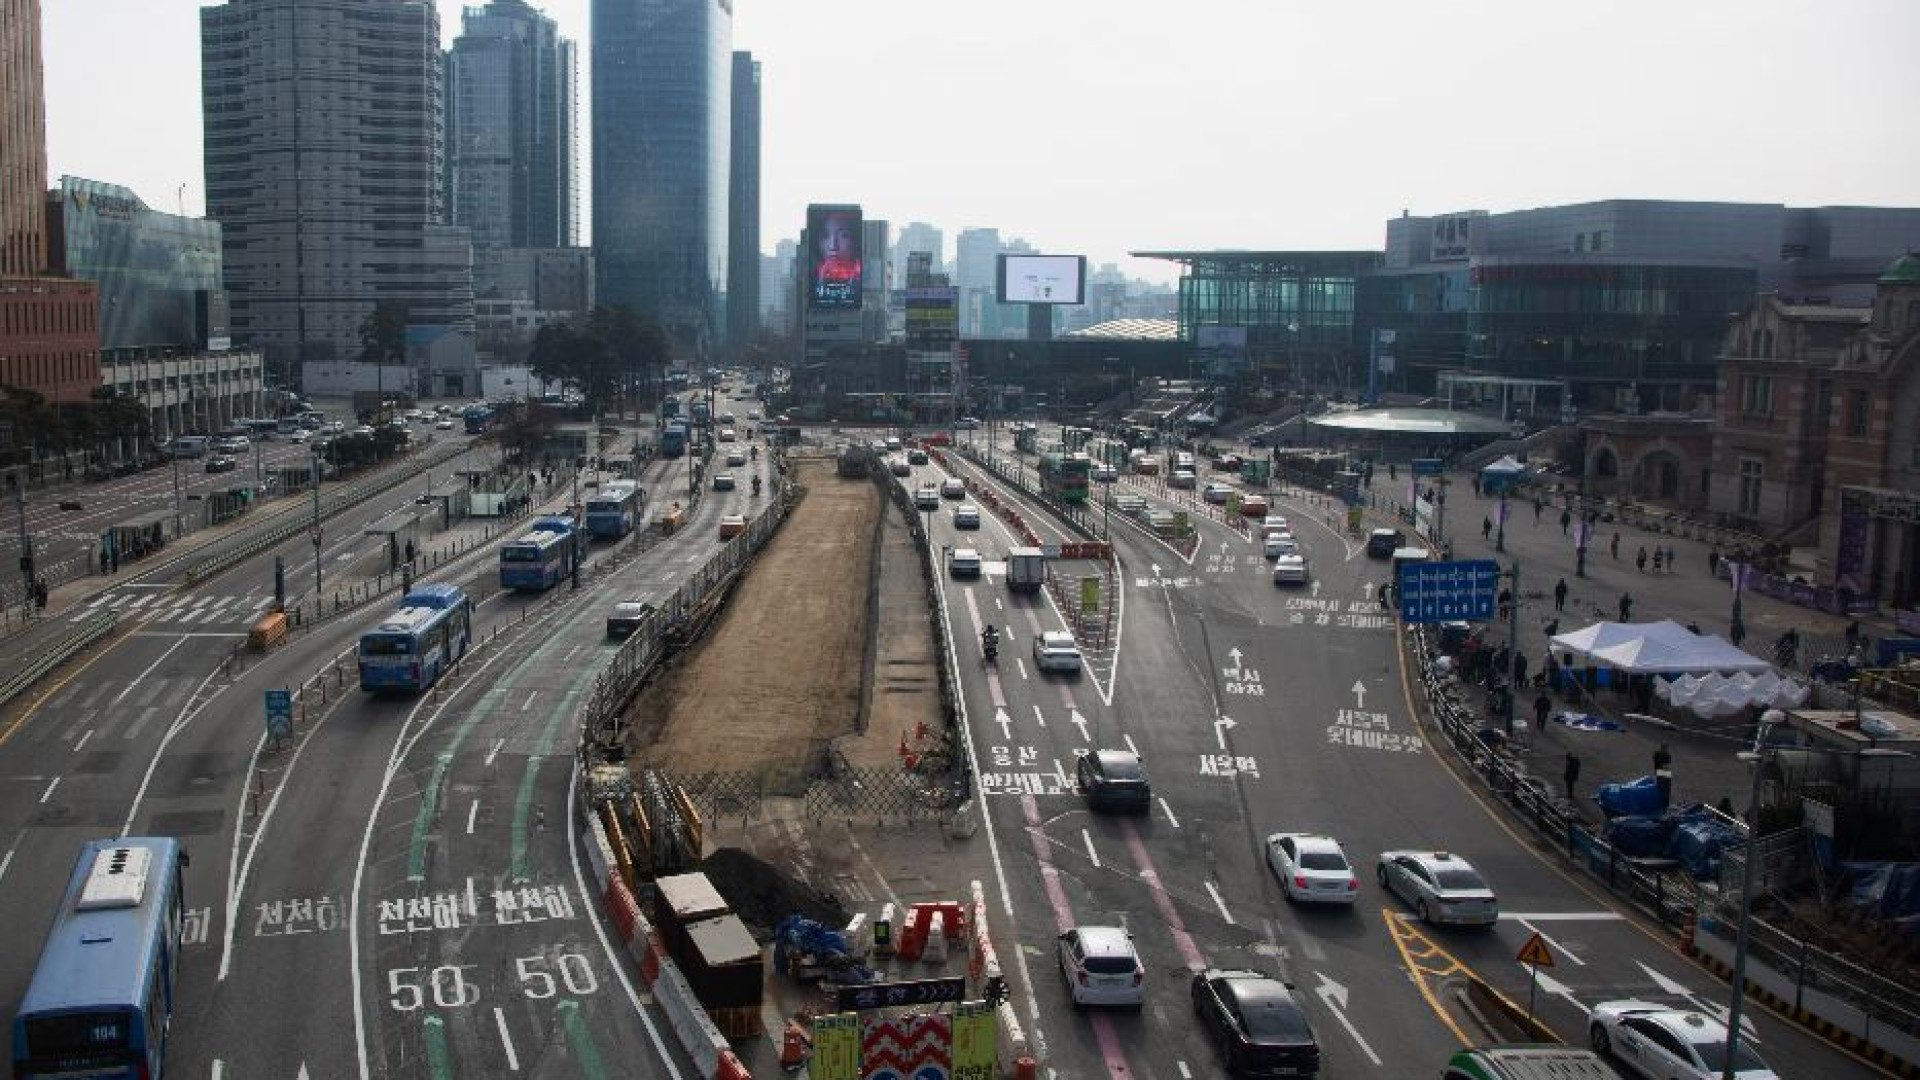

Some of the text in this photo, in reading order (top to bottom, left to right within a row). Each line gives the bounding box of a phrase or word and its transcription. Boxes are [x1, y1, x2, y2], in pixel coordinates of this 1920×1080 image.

[1200, 755, 1260, 779] 서울역
[254, 896, 347, 936] 천천히
[376, 895, 460, 935] 천천히
[388, 966, 466, 1011] 50
[516, 954, 597, 998] 50
